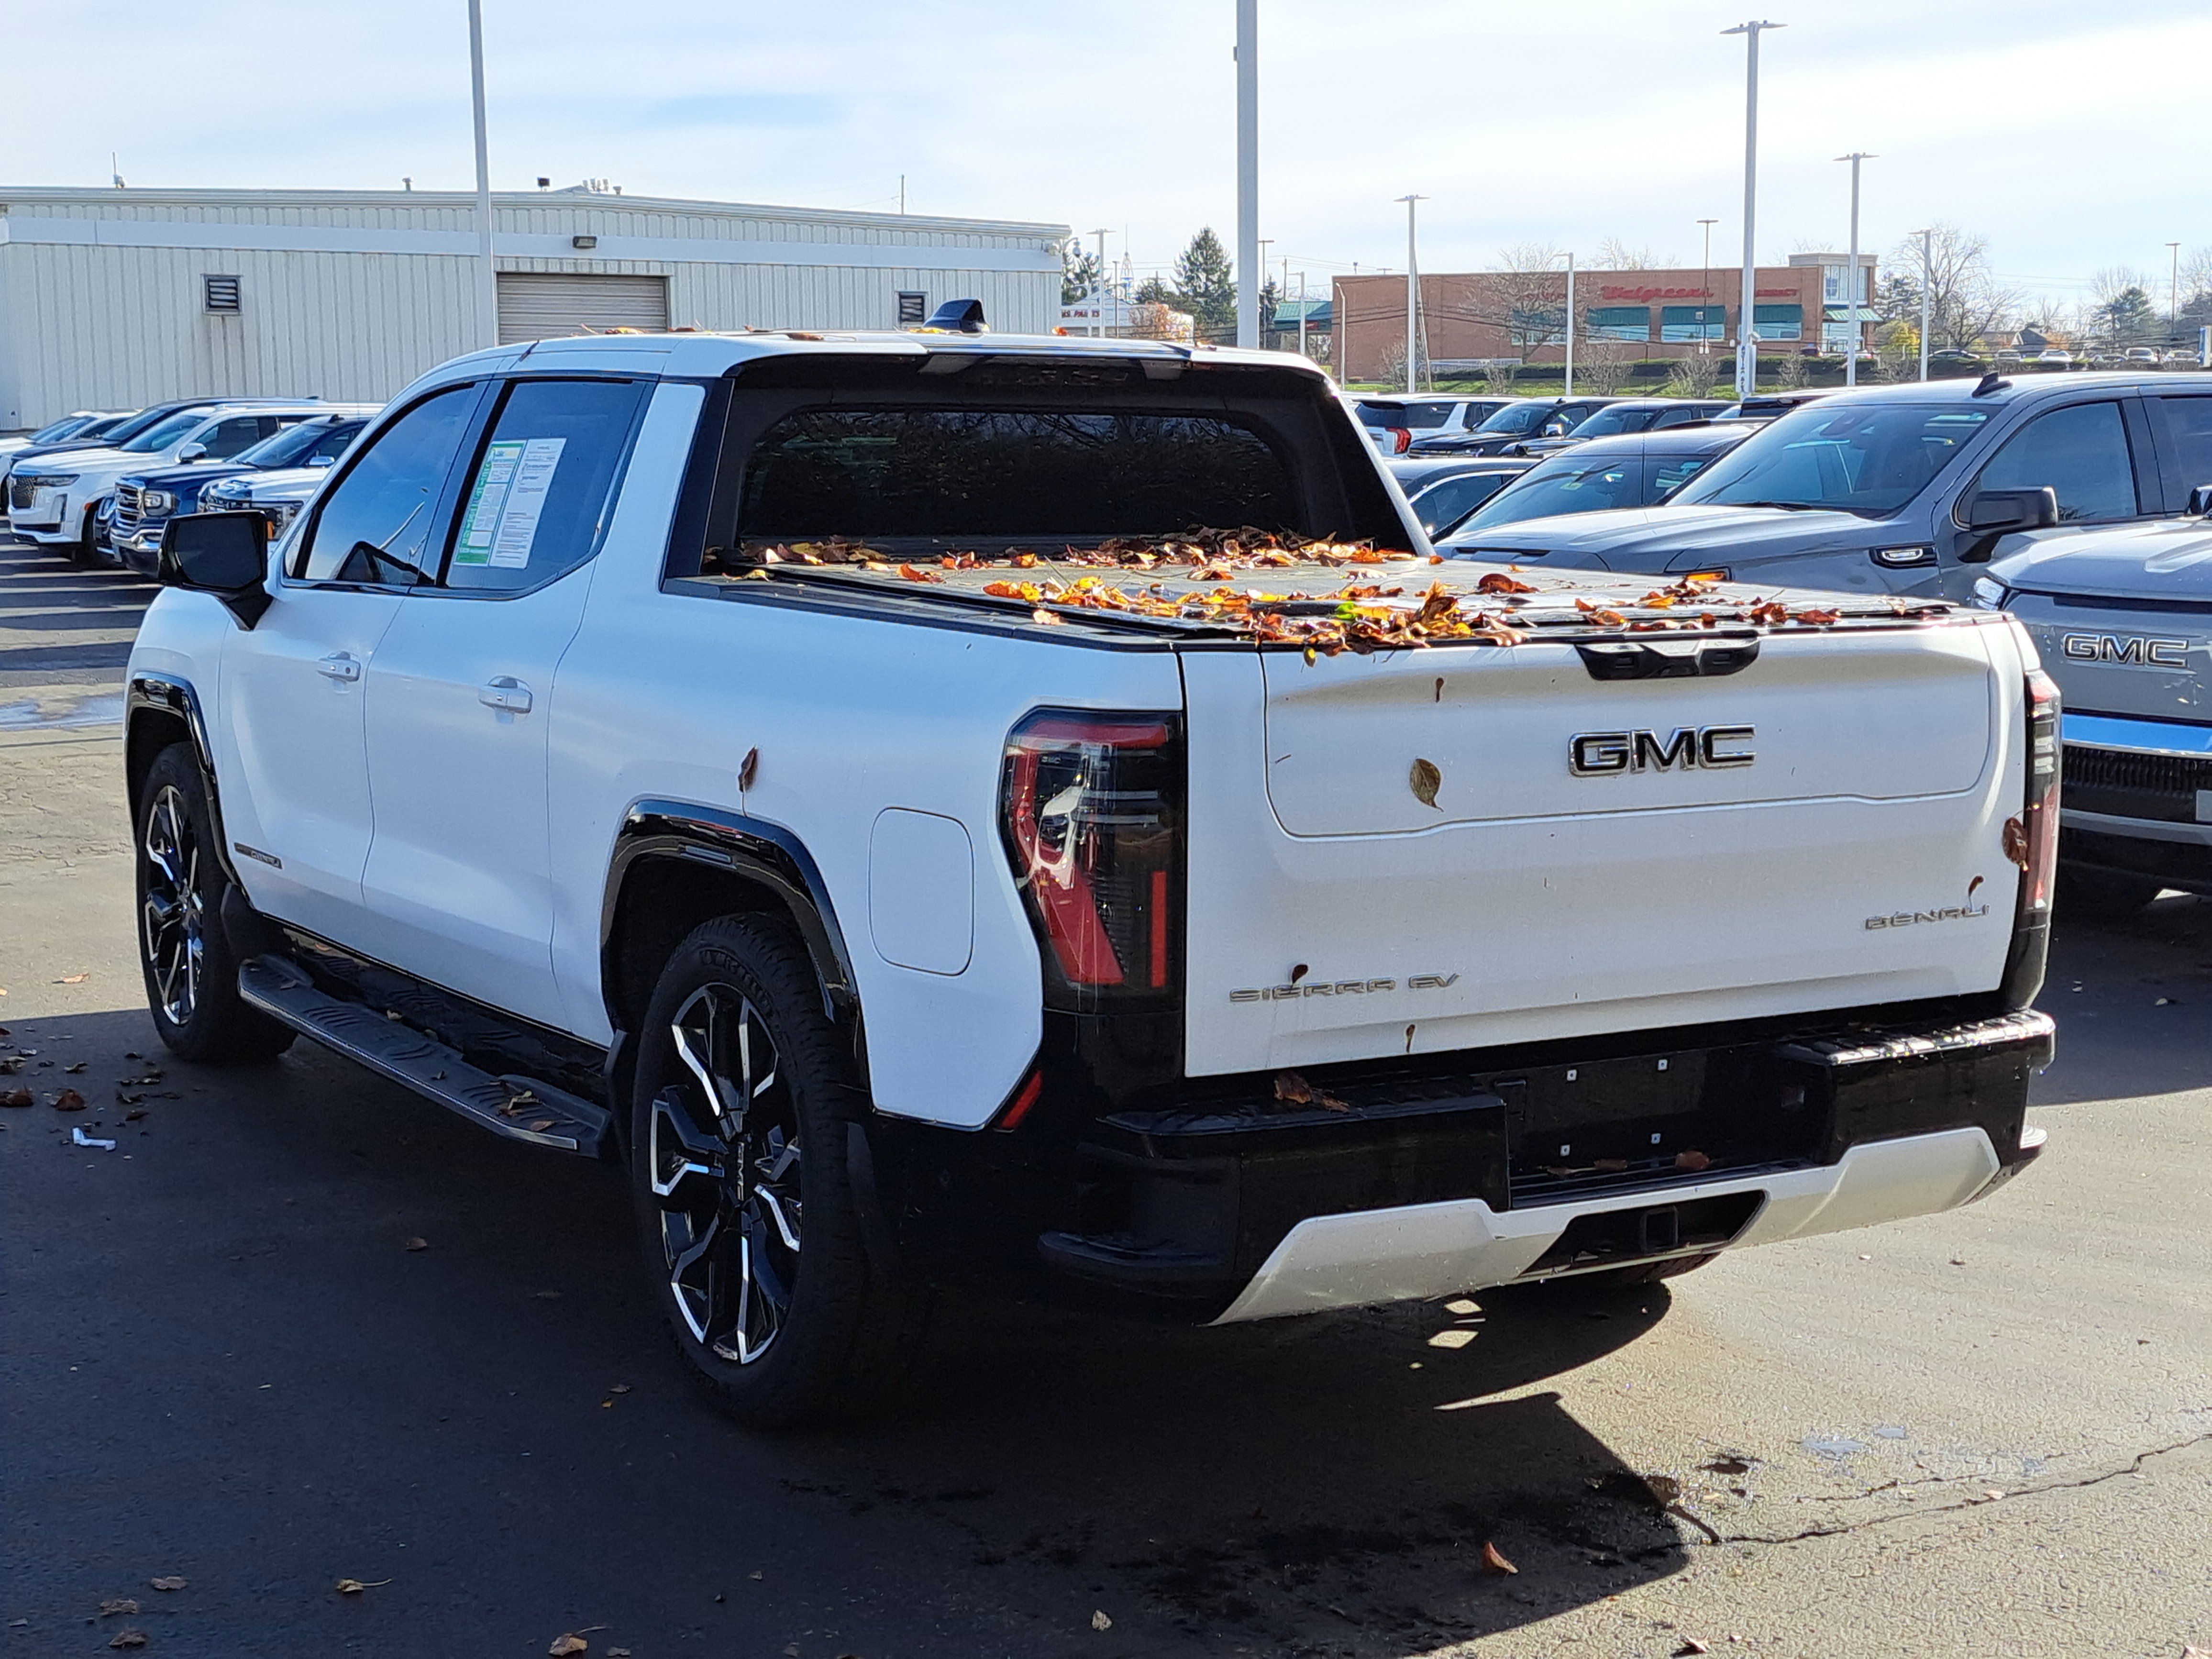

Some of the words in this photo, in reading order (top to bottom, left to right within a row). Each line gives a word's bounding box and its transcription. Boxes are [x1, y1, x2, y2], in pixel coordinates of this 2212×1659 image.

[1601, 286, 1714, 303] Walgreens
[2063, 632, 2189, 668] GMC
[1568, 722, 1757, 778] GMC
[1865, 904, 1990, 930] DENALI
[1229, 977, 1396, 1002] SIERRA
[1408, 973, 1460, 989] EV
